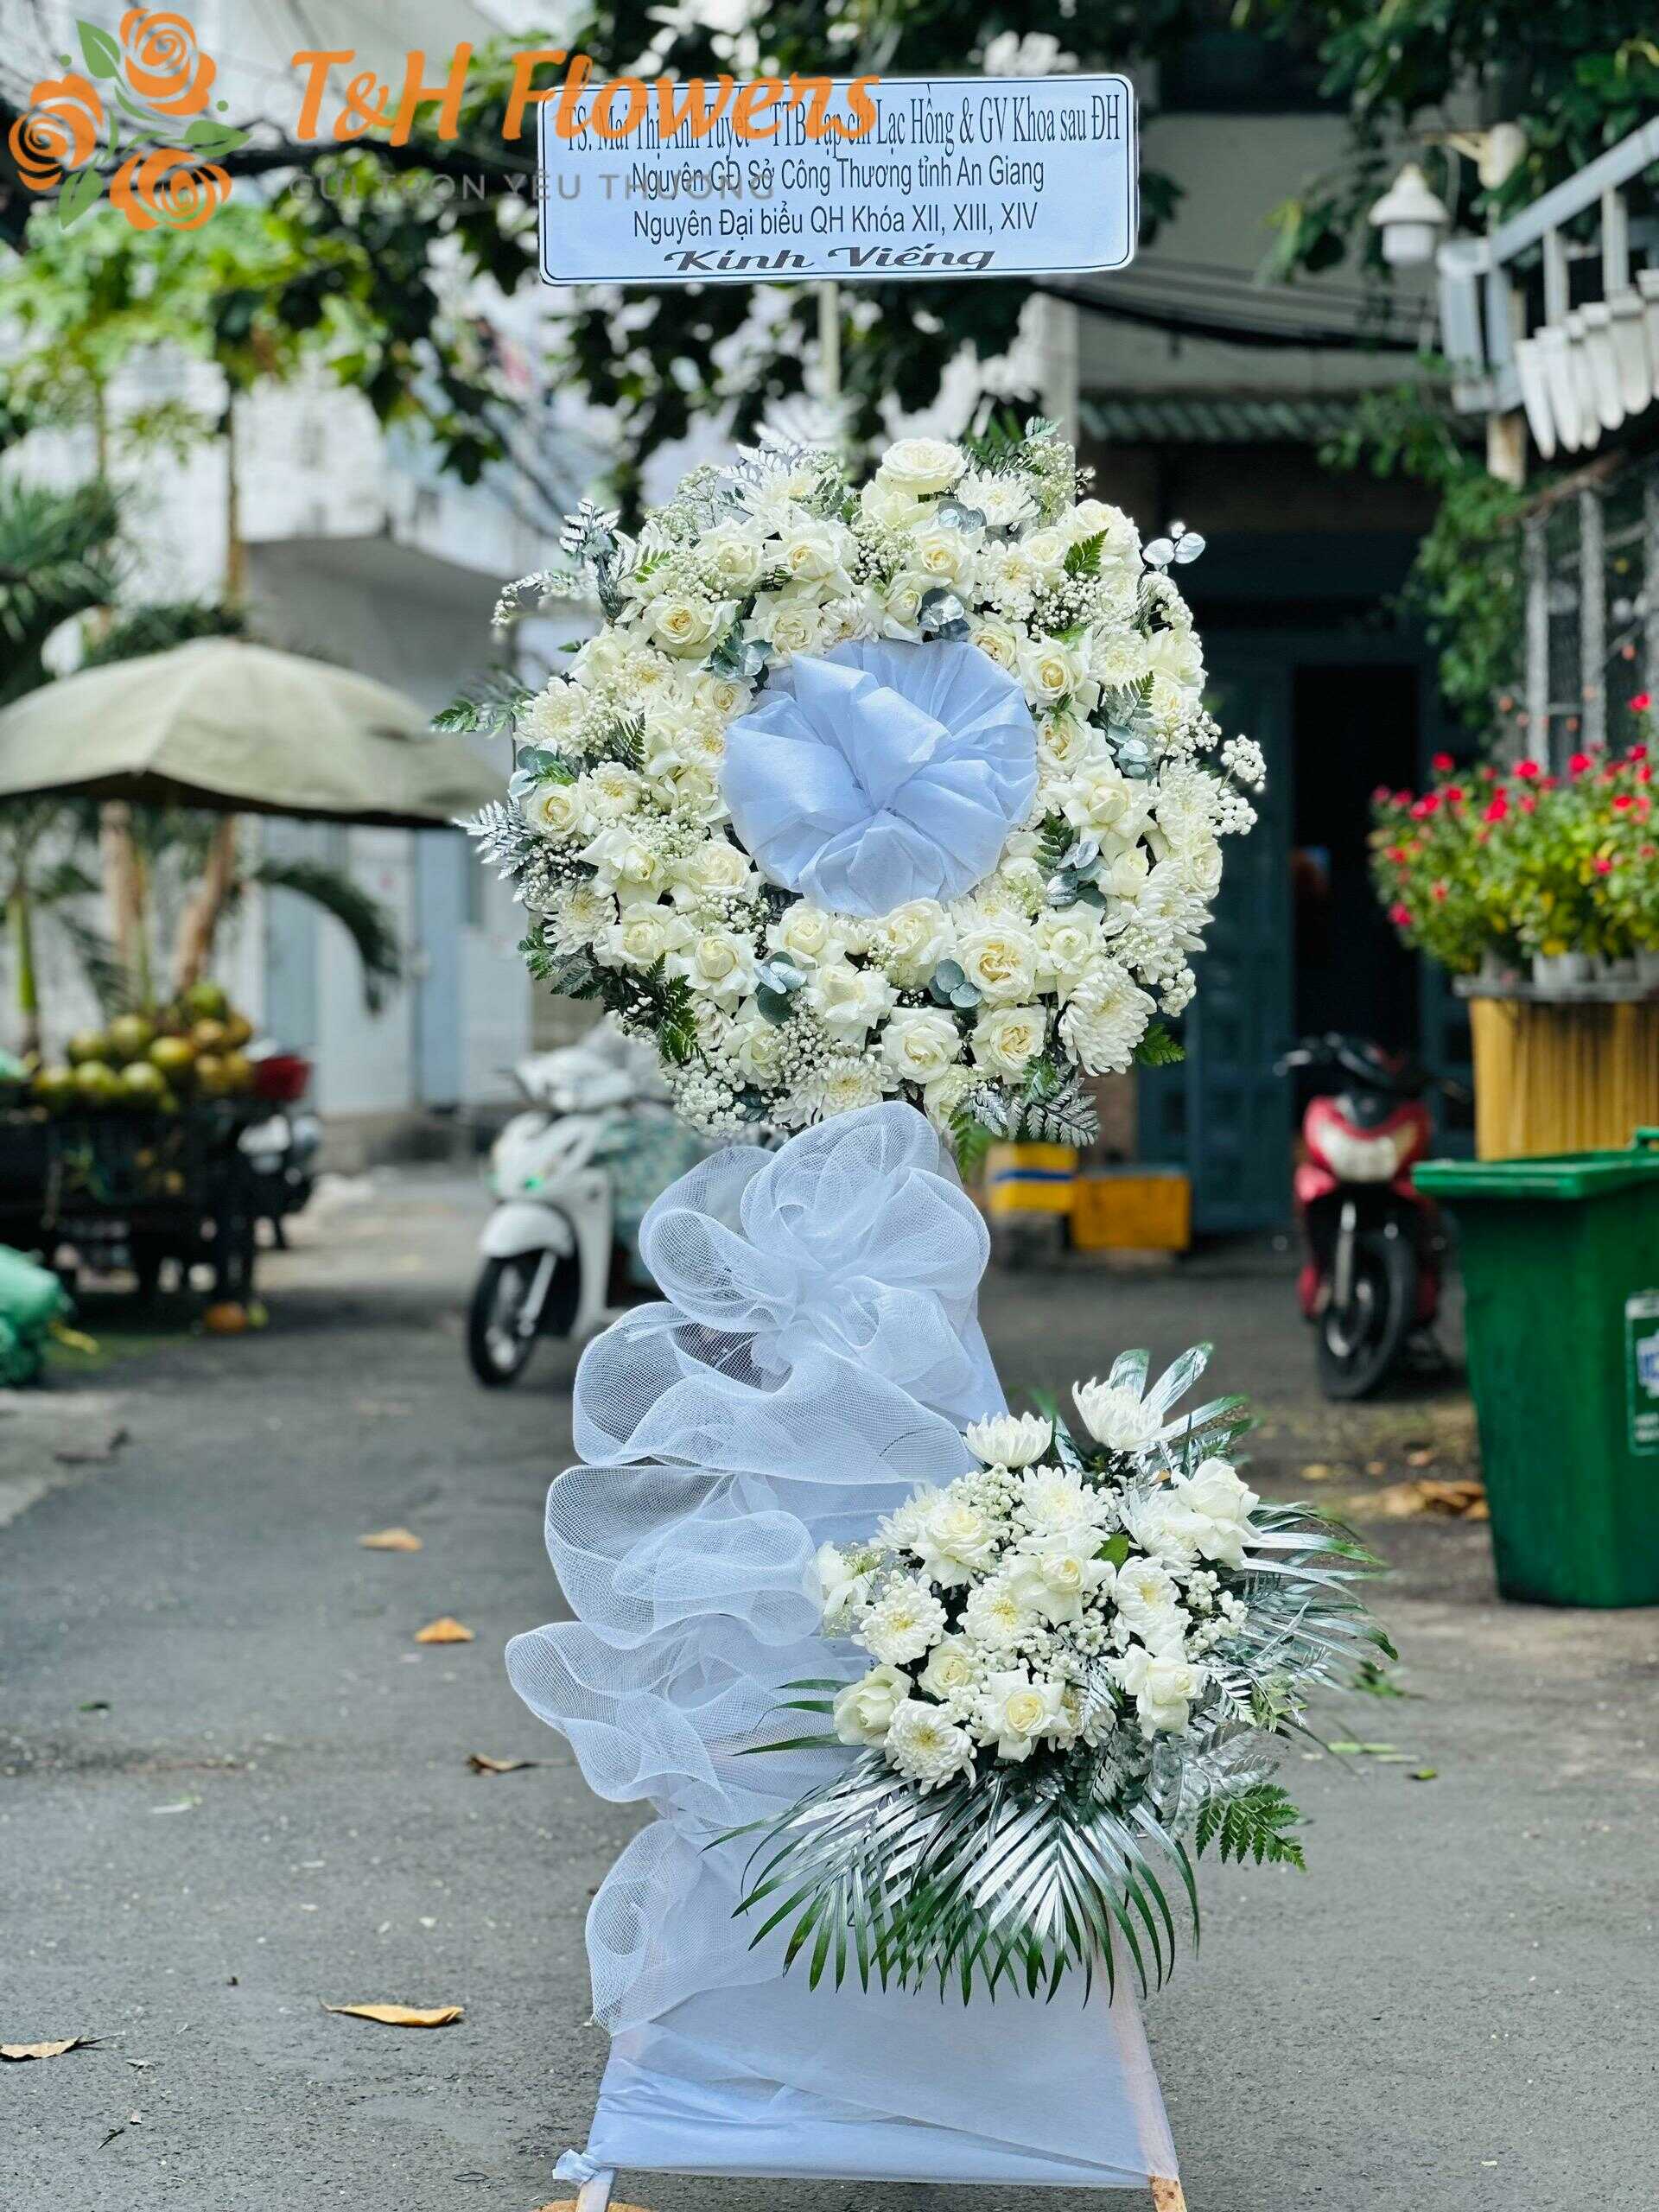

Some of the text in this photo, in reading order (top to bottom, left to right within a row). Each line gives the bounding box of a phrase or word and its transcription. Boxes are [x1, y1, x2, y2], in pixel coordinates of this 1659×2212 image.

[875, 98, 906, 156] Lạc
[910, 83, 955, 157] Hồng
[959, 97, 974, 144] &
[980, 96, 1014, 143] GV
[1012, 94, 1054, 143] Khoa
[1060, 107, 1086, 142] sau
[1091, 93, 1121, 141] ĐH
[632, 154, 1045, 200] Nguyên GĐ Sở Công Thương tỉnh An Giang
[633, 200, 1039, 245] Nguyên Đại biểu QH Khóa XII, XIII, XIV
[827, 242, 996, 271] Viếng
